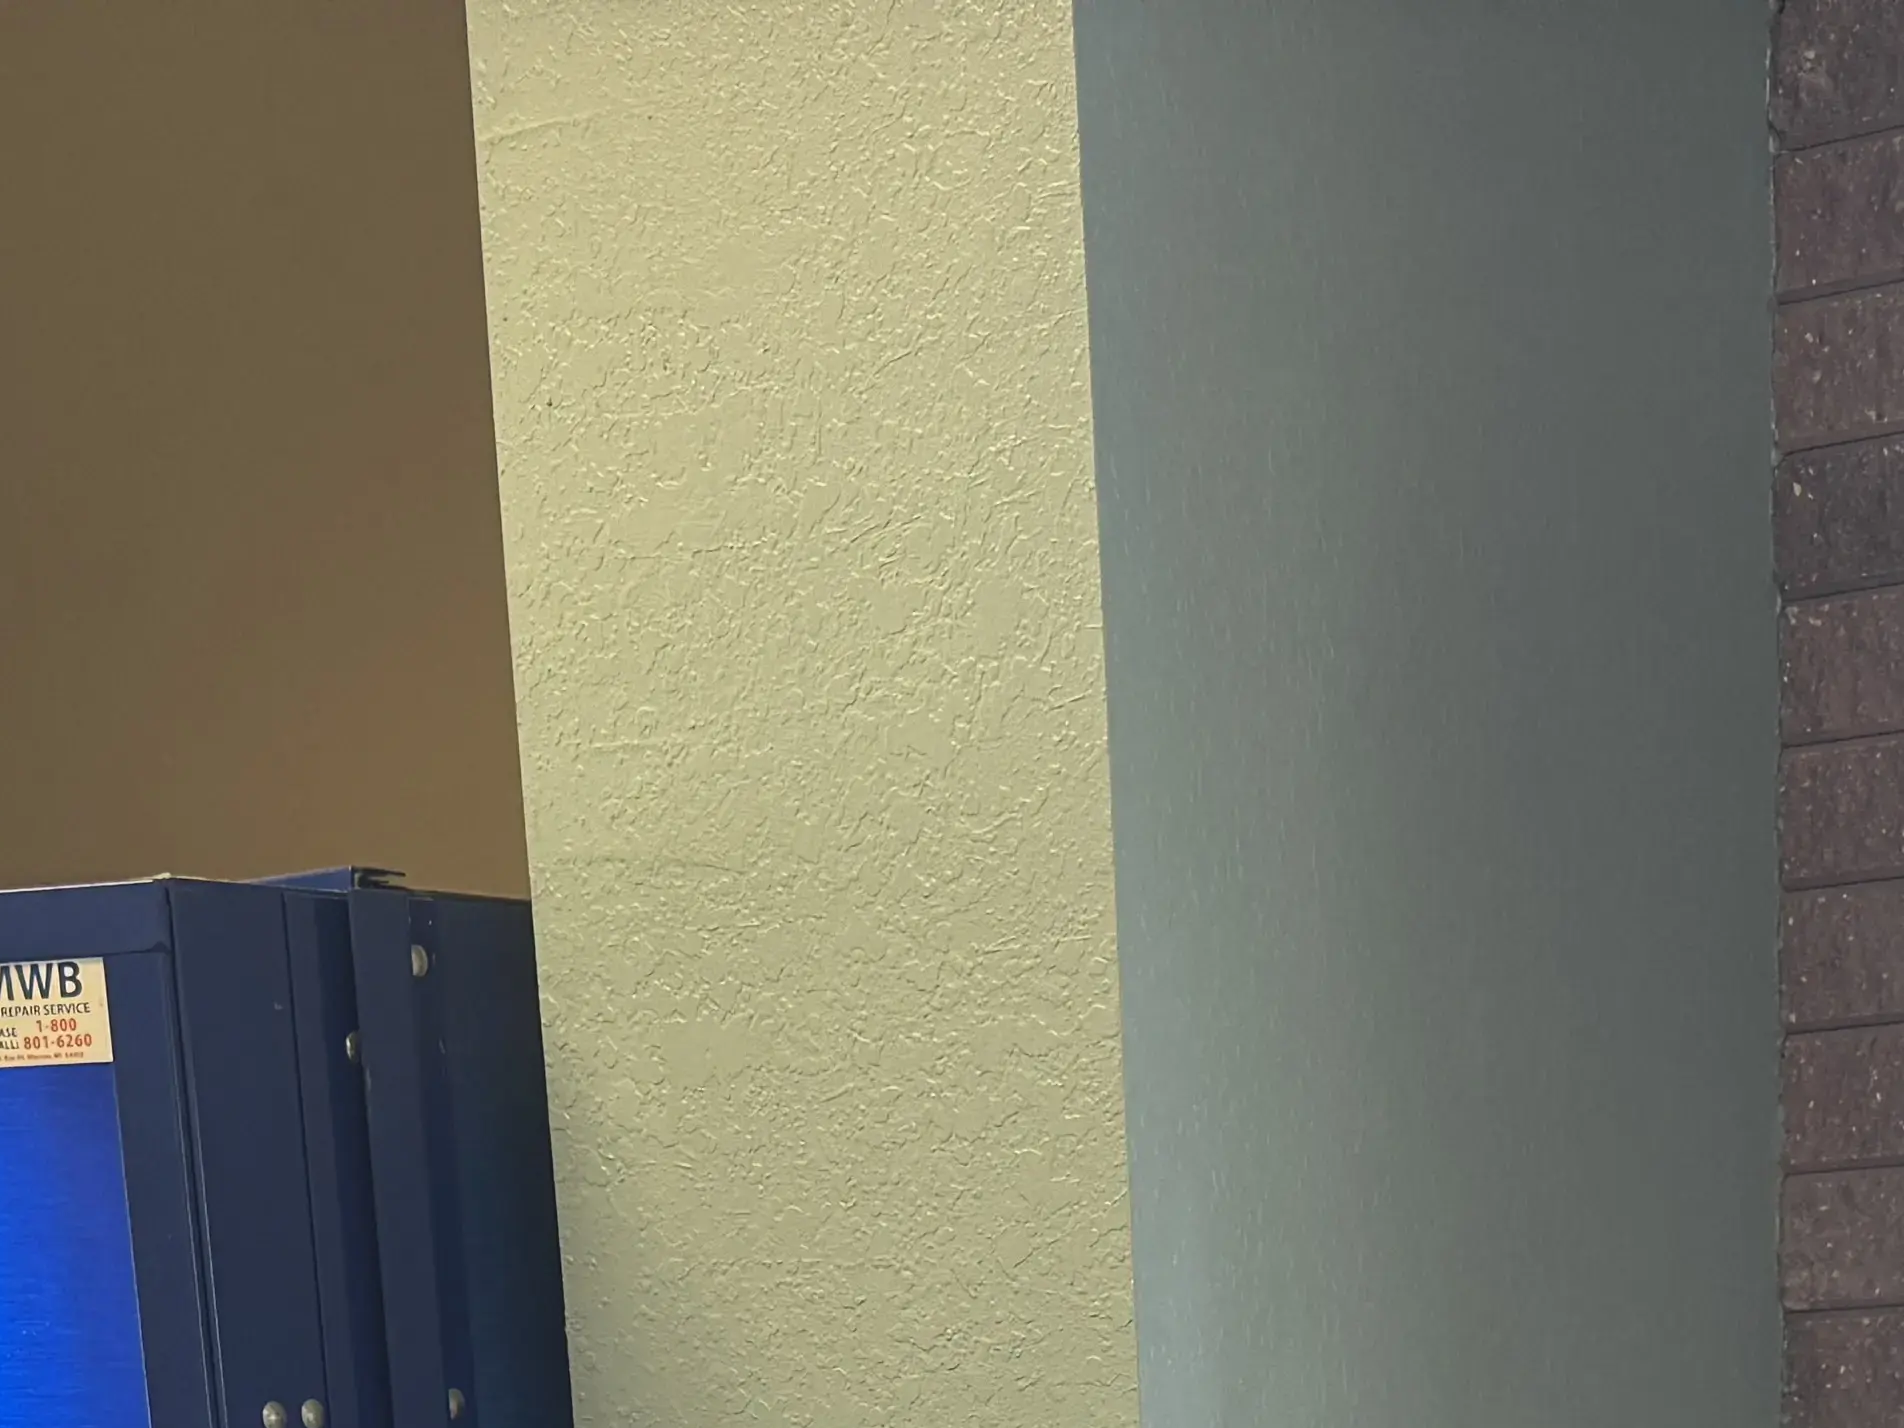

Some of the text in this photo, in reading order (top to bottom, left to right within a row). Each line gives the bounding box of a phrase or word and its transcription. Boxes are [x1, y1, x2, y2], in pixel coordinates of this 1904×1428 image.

[1, 1005, 40, 1017] REPAIR
[44, 1002, 91, 1015] SERVICE
[36, 1018, 77, 1032] 1-800
[24, 1033, 92, 1050] 801-6260
